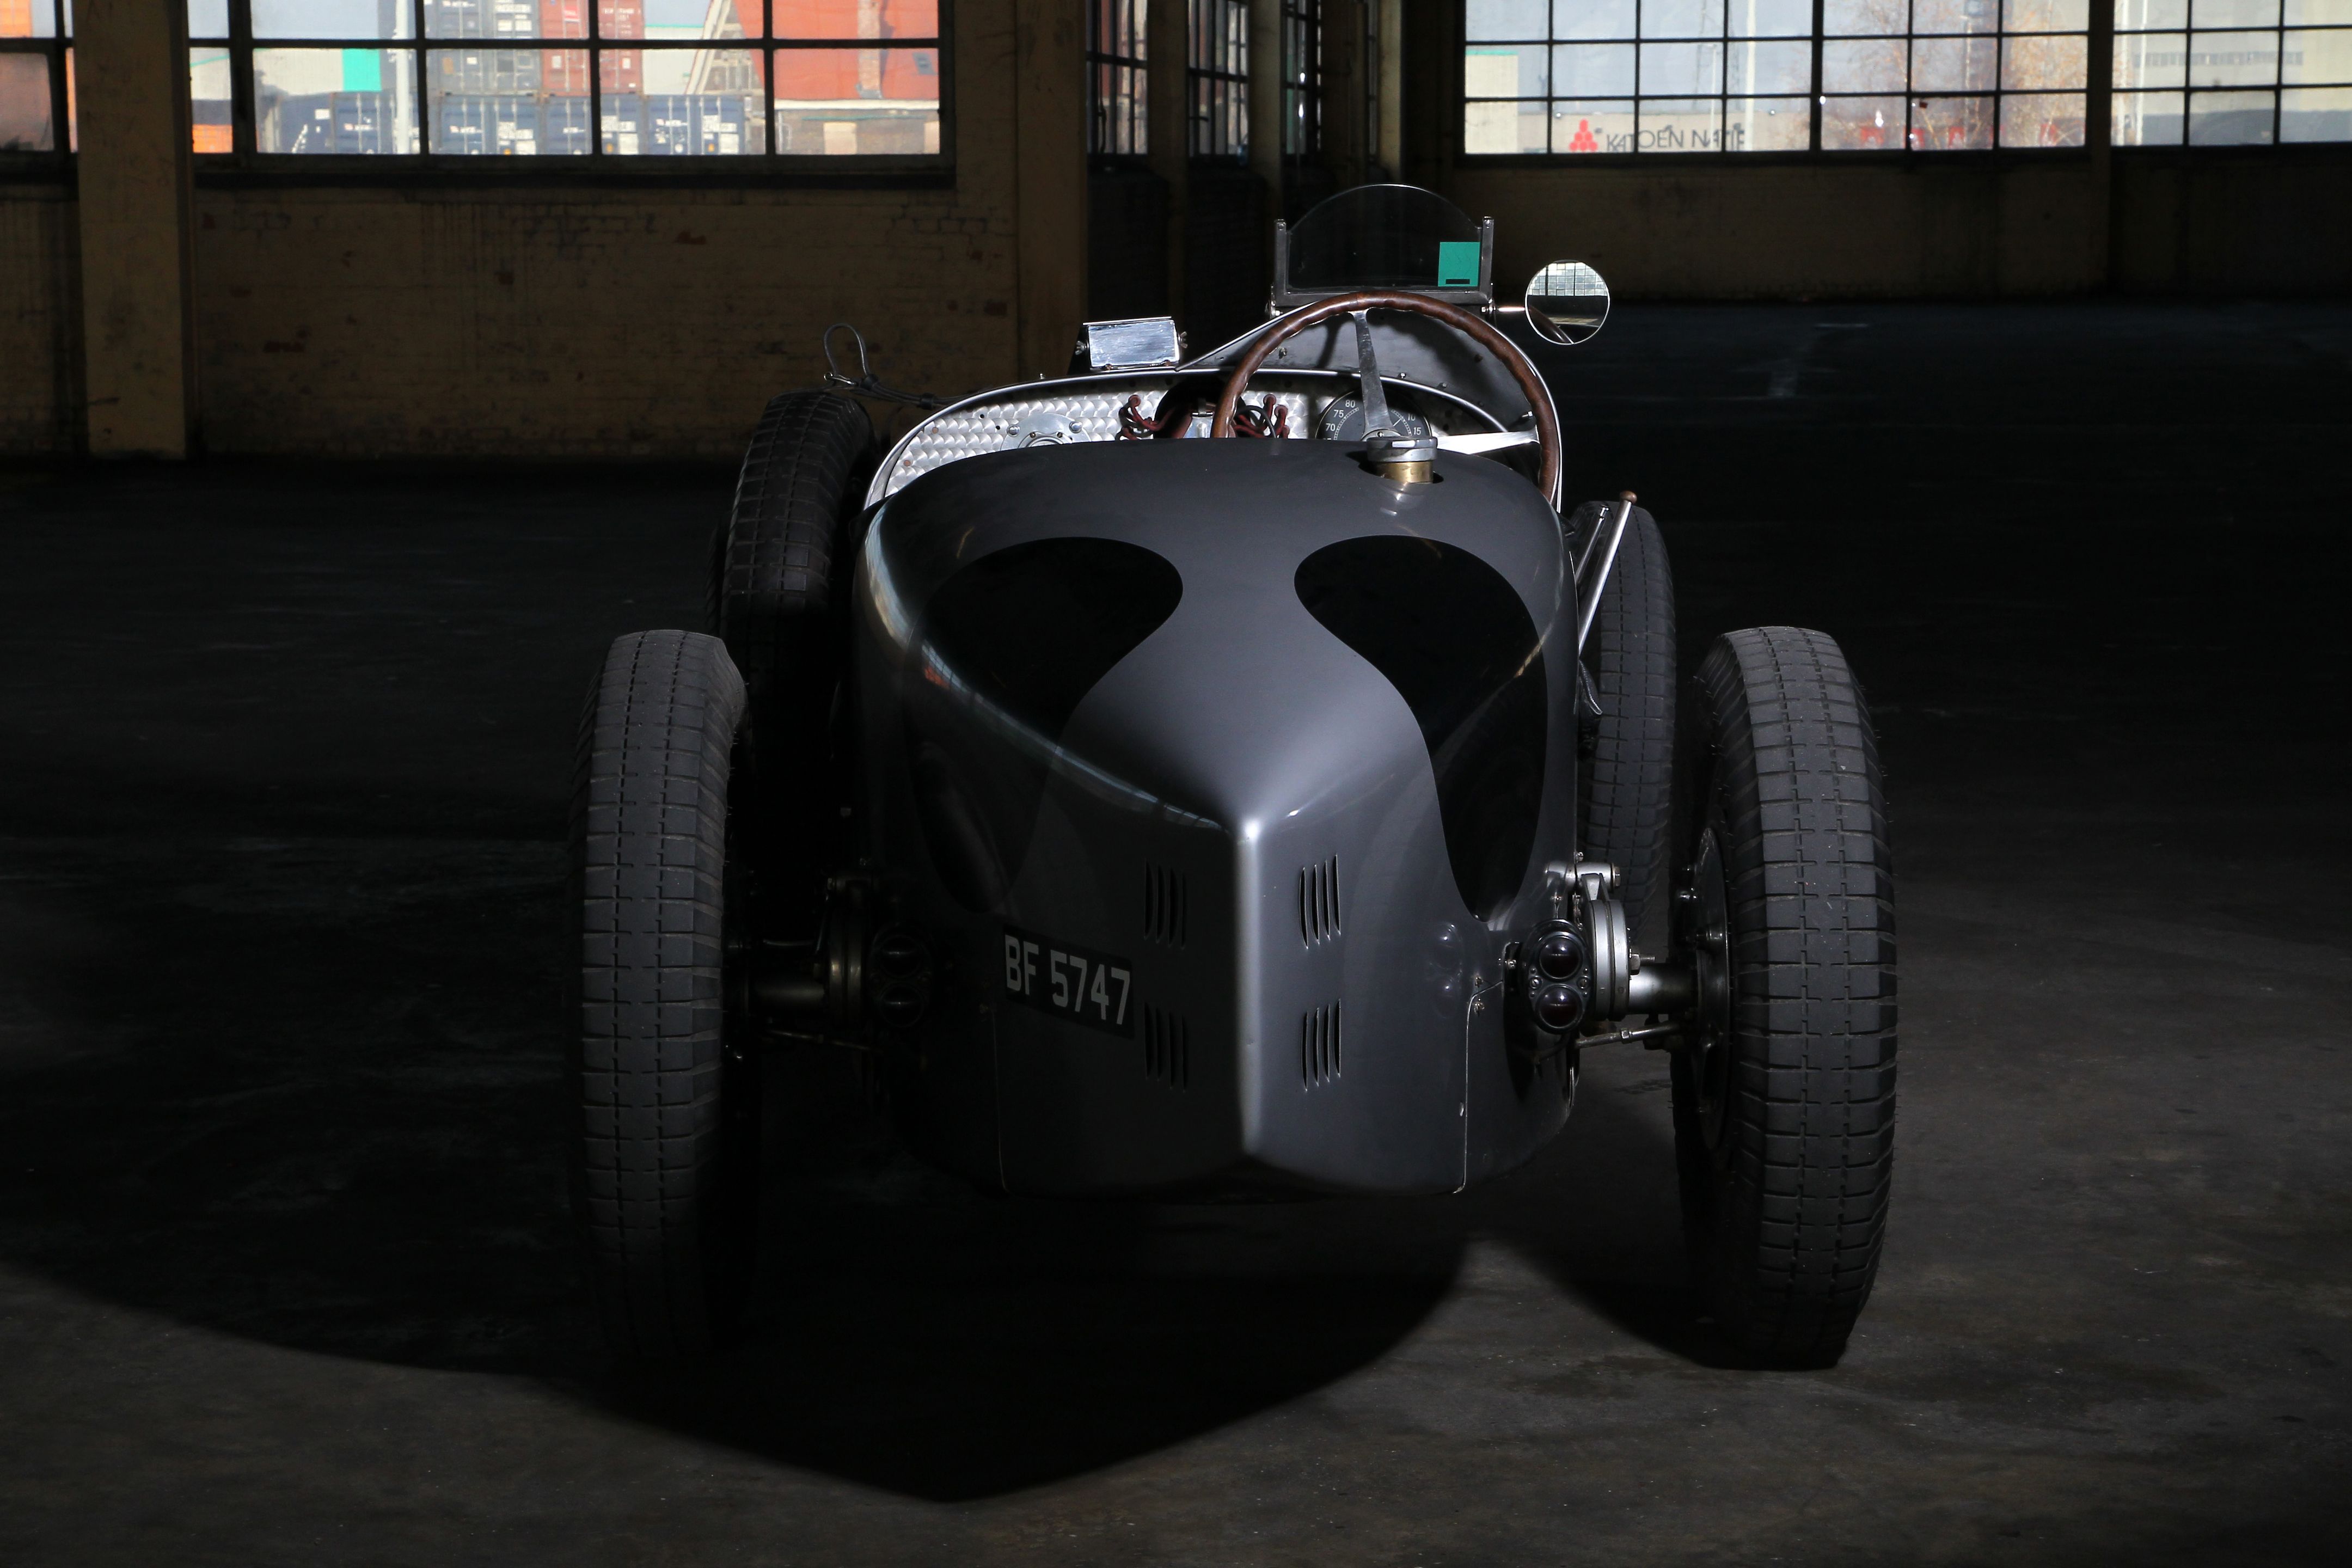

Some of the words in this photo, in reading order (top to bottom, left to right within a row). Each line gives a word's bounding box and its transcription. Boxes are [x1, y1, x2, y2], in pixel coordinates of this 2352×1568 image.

[1607, 130, 1683, 151] KATOEN
[1345, 400, 1356, 408] 80
[1334, 409, 1344, 418] 75
[1407, 413, 1416, 421] 10
[1325, 423, 1336, 432] 70
[1413, 427, 1422, 436] 15
[1005, 934, 1039, 996] BF
[1050, 949, 1130, 1025] 5747
